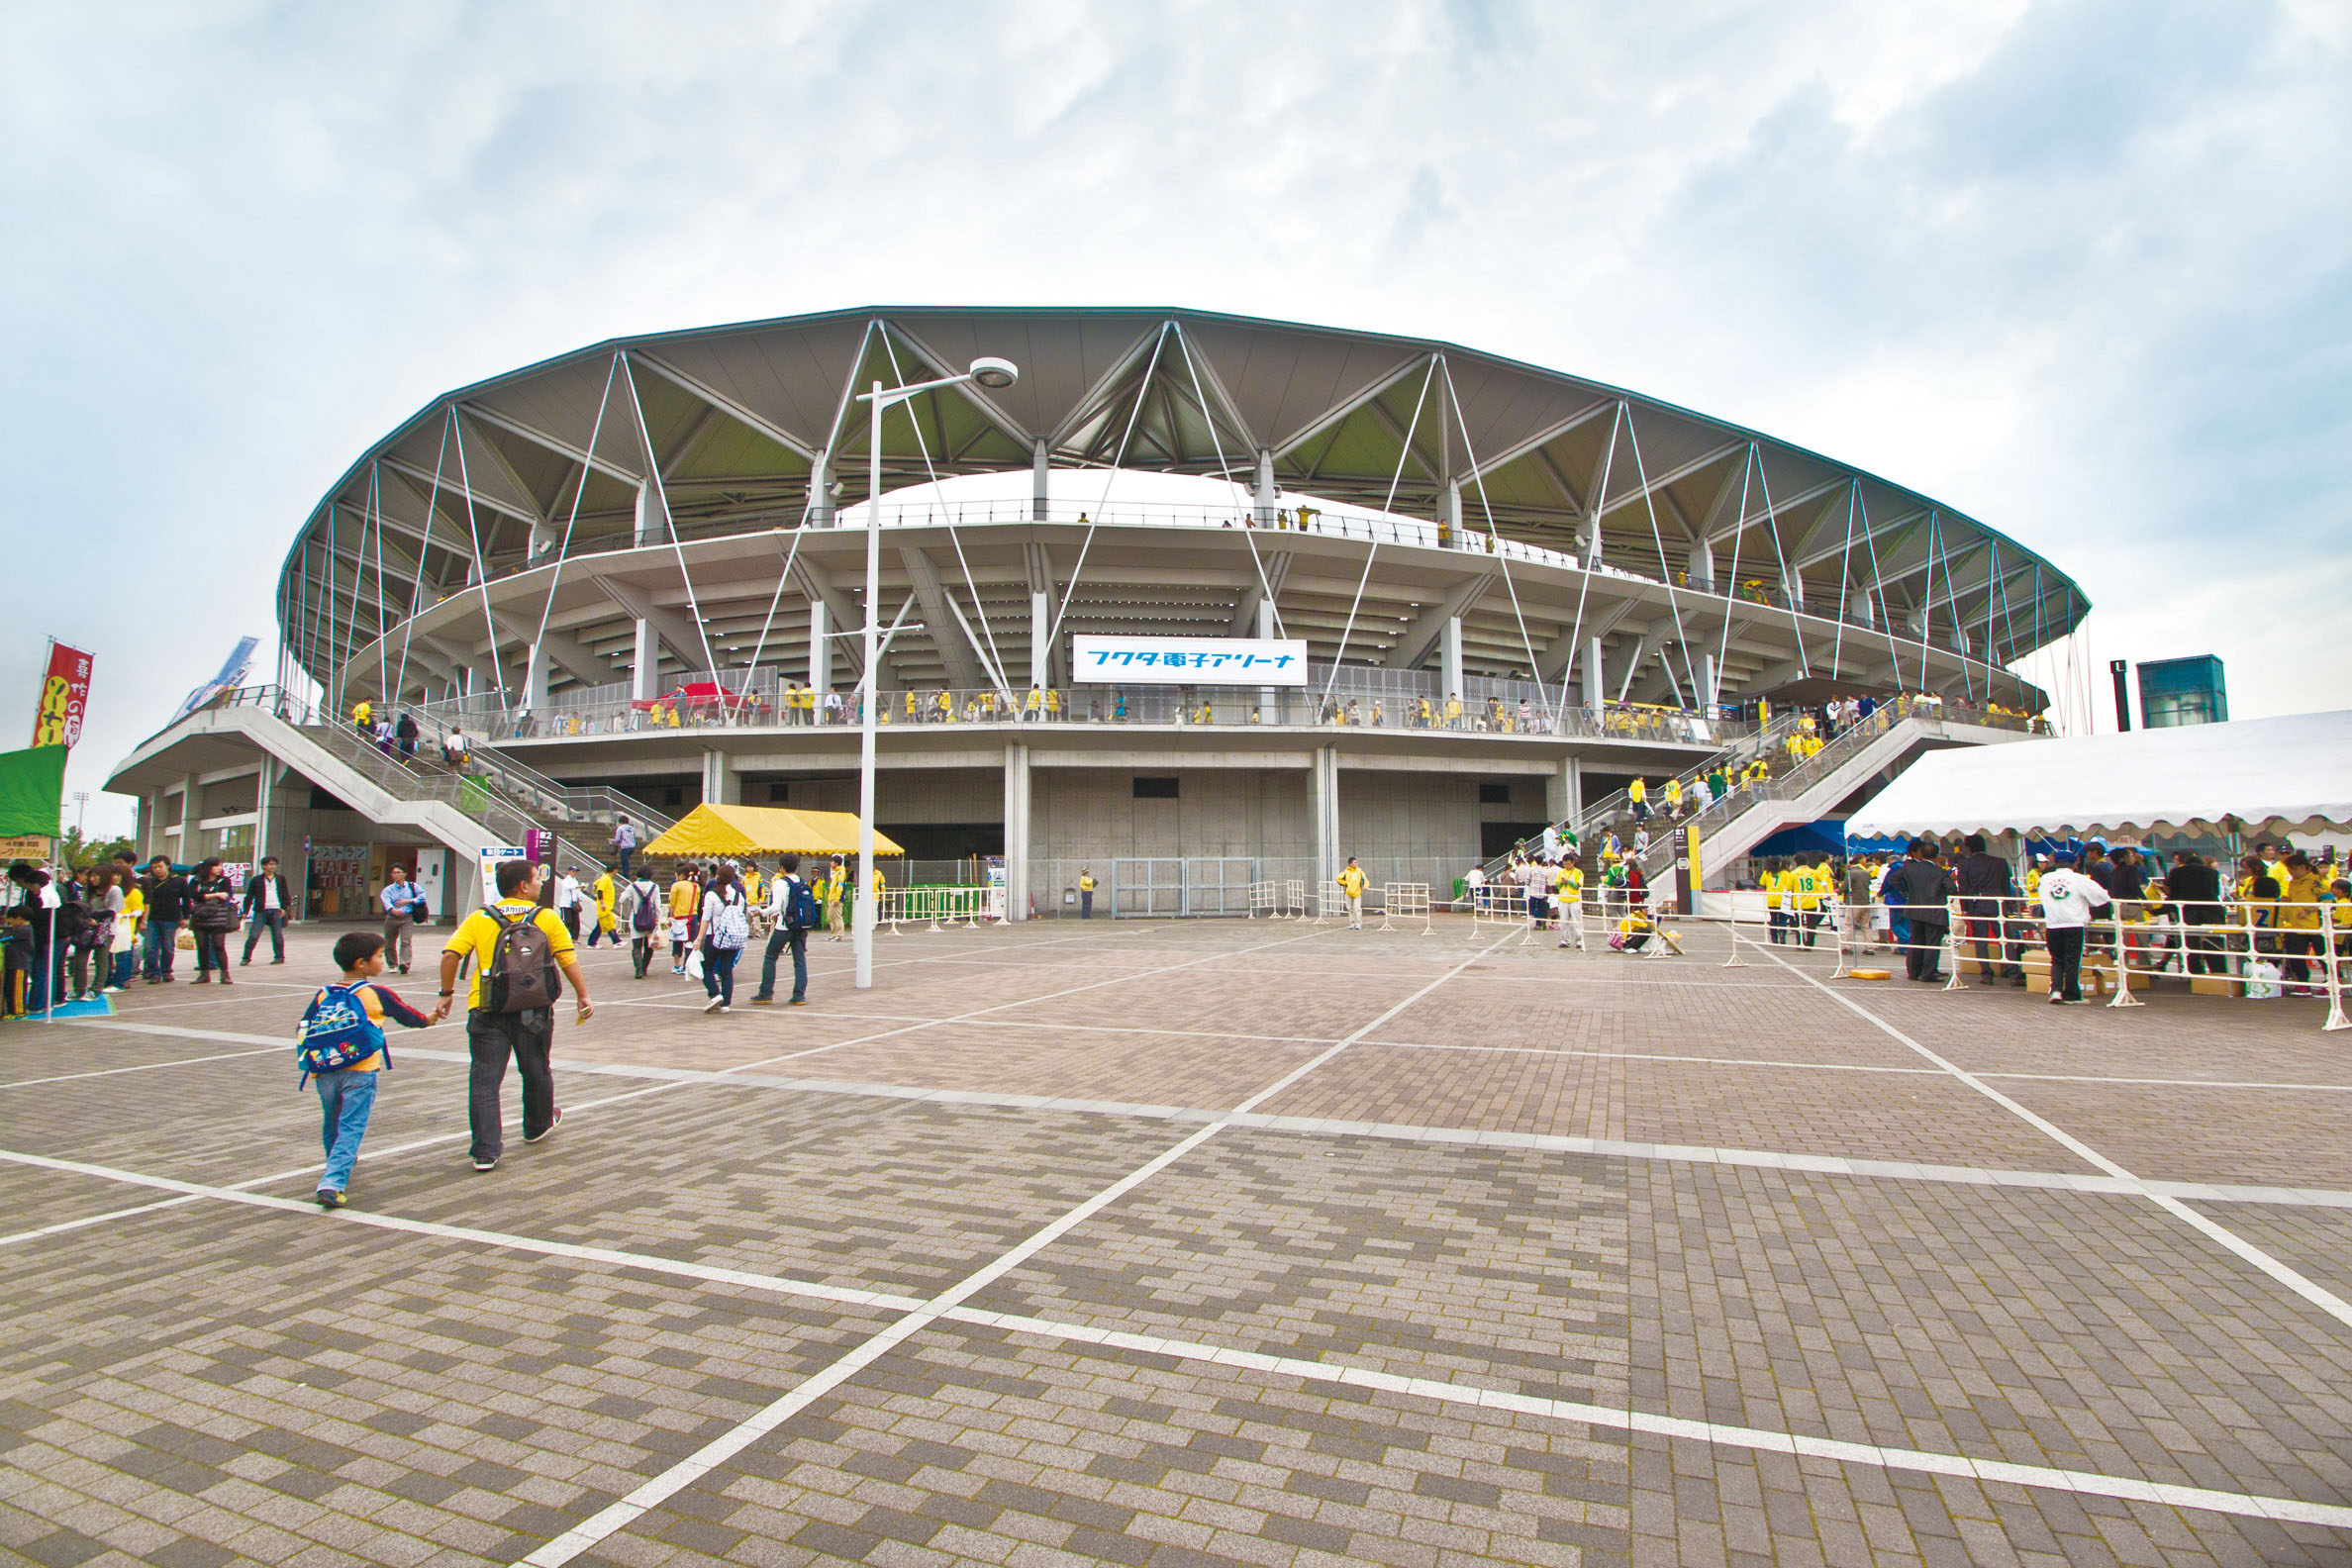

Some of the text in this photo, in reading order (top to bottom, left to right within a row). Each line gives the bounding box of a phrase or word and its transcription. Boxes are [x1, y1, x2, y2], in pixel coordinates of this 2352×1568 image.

[1087, 650, 1295, 668] フクダ電子アリーナ
[311, 846, 365, 858] レストラン
[314, 862, 358, 874] HALF
[320, 875, 363, 887] TIME
[1773, 875, 1780, 887] 7
[1799, 877, 1813, 891] 18
[2256, 909, 2270, 927] 2
